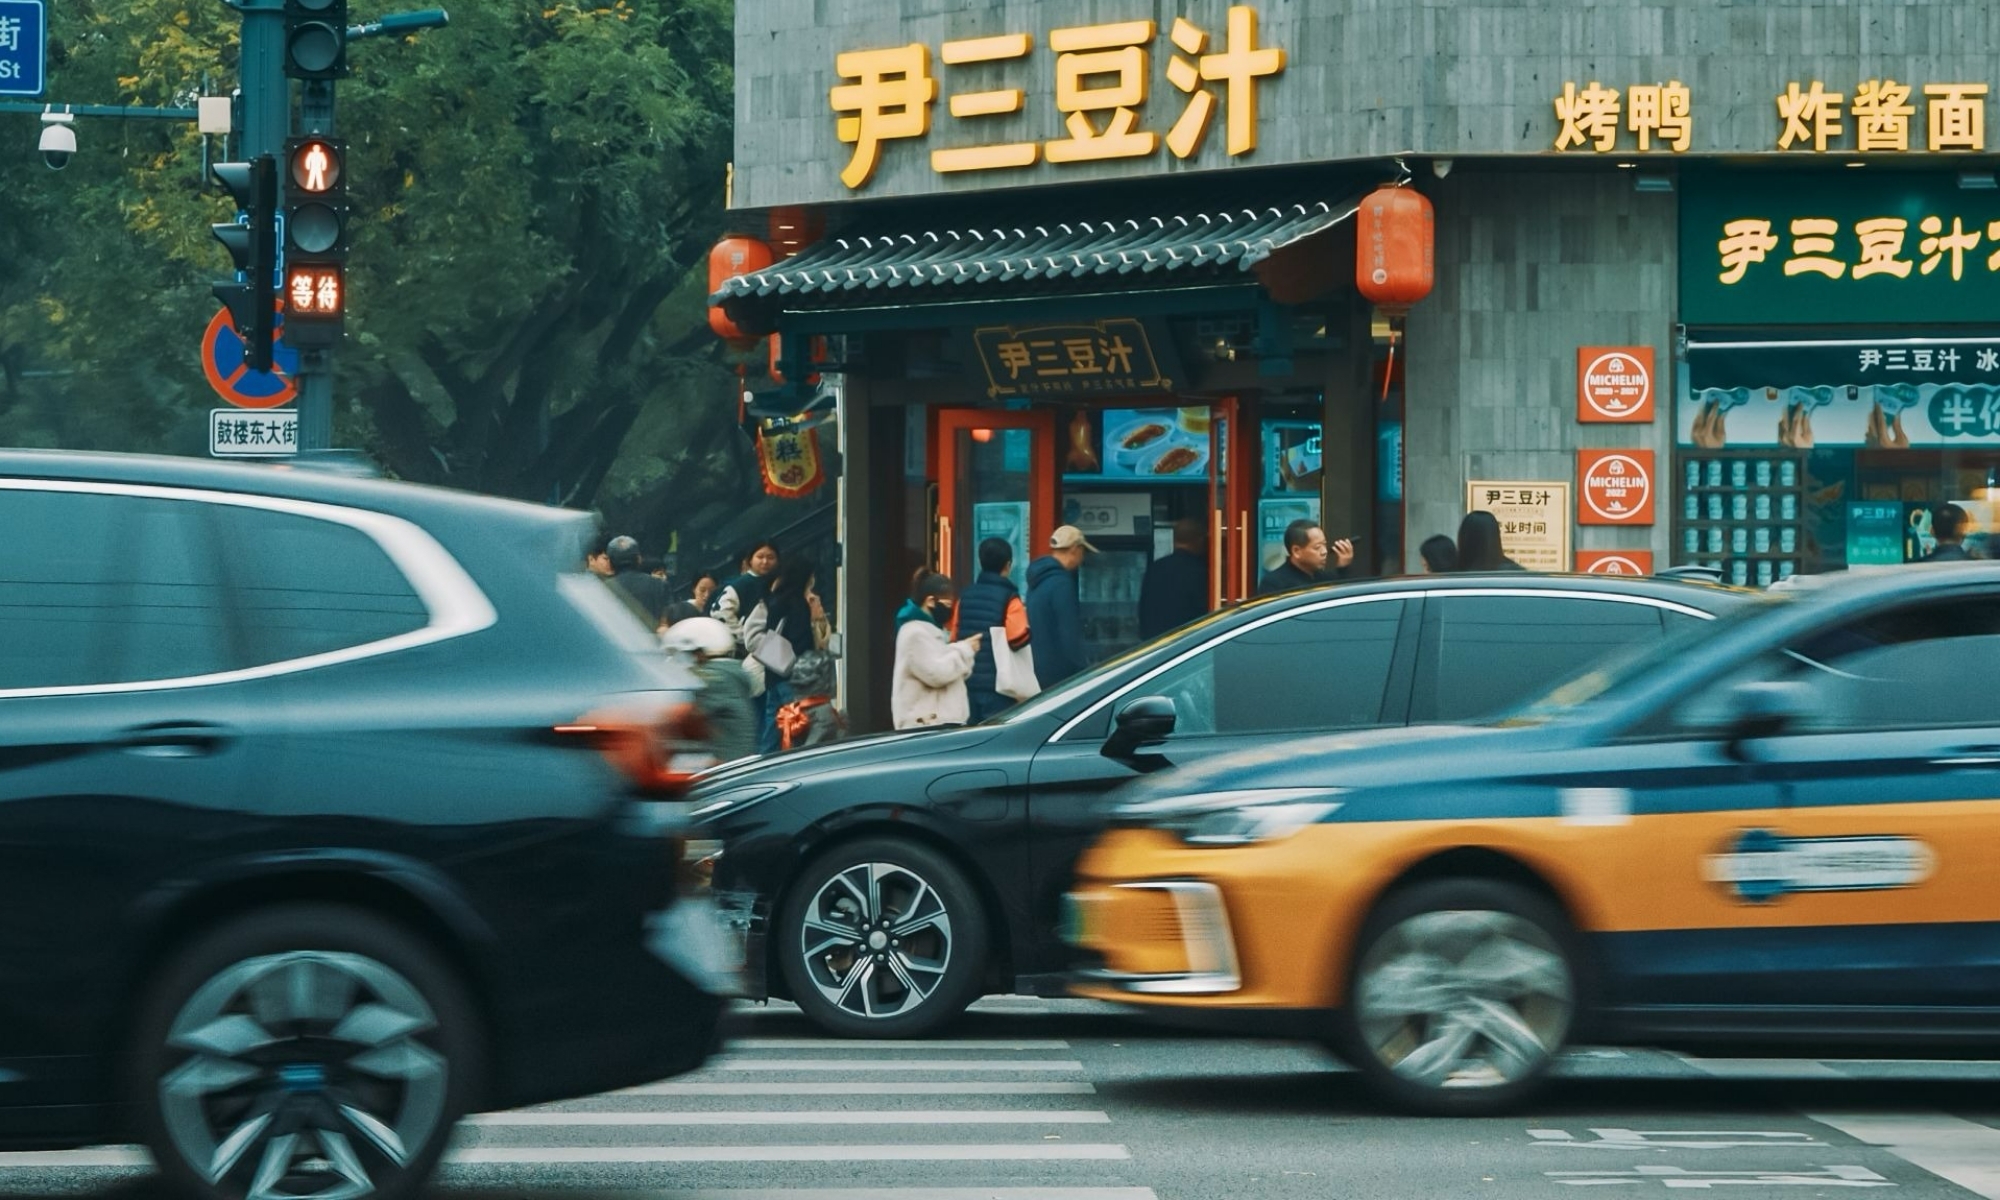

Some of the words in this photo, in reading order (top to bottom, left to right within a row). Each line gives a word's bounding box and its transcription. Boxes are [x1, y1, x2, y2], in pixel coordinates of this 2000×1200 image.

[828, 4, 1288, 190] 尹三豆汁
[1554, 80, 1693, 152] 烤鸭
[1777, 79, 1989, 152] 炸酱面
[1717, 215, 2000, 284] 尹三豆汁
[291, 275, 338, 310] 等待
[998, 335, 1133, 380] 尹三豆汁
[1858, 348, 1961, 373] 尹三豆汁
[1976, 348, 2000, 372] 冰
[1589, 374, 1645, 386] MICHELIN
[217, 418, 298, 446] 鼓楼东大街
[1589, 476, 1645, 488] MICHELIN
[1486, 490, 1551, 506] 尹三豆汁
[1498, 521, 1547, 535] 业时间
